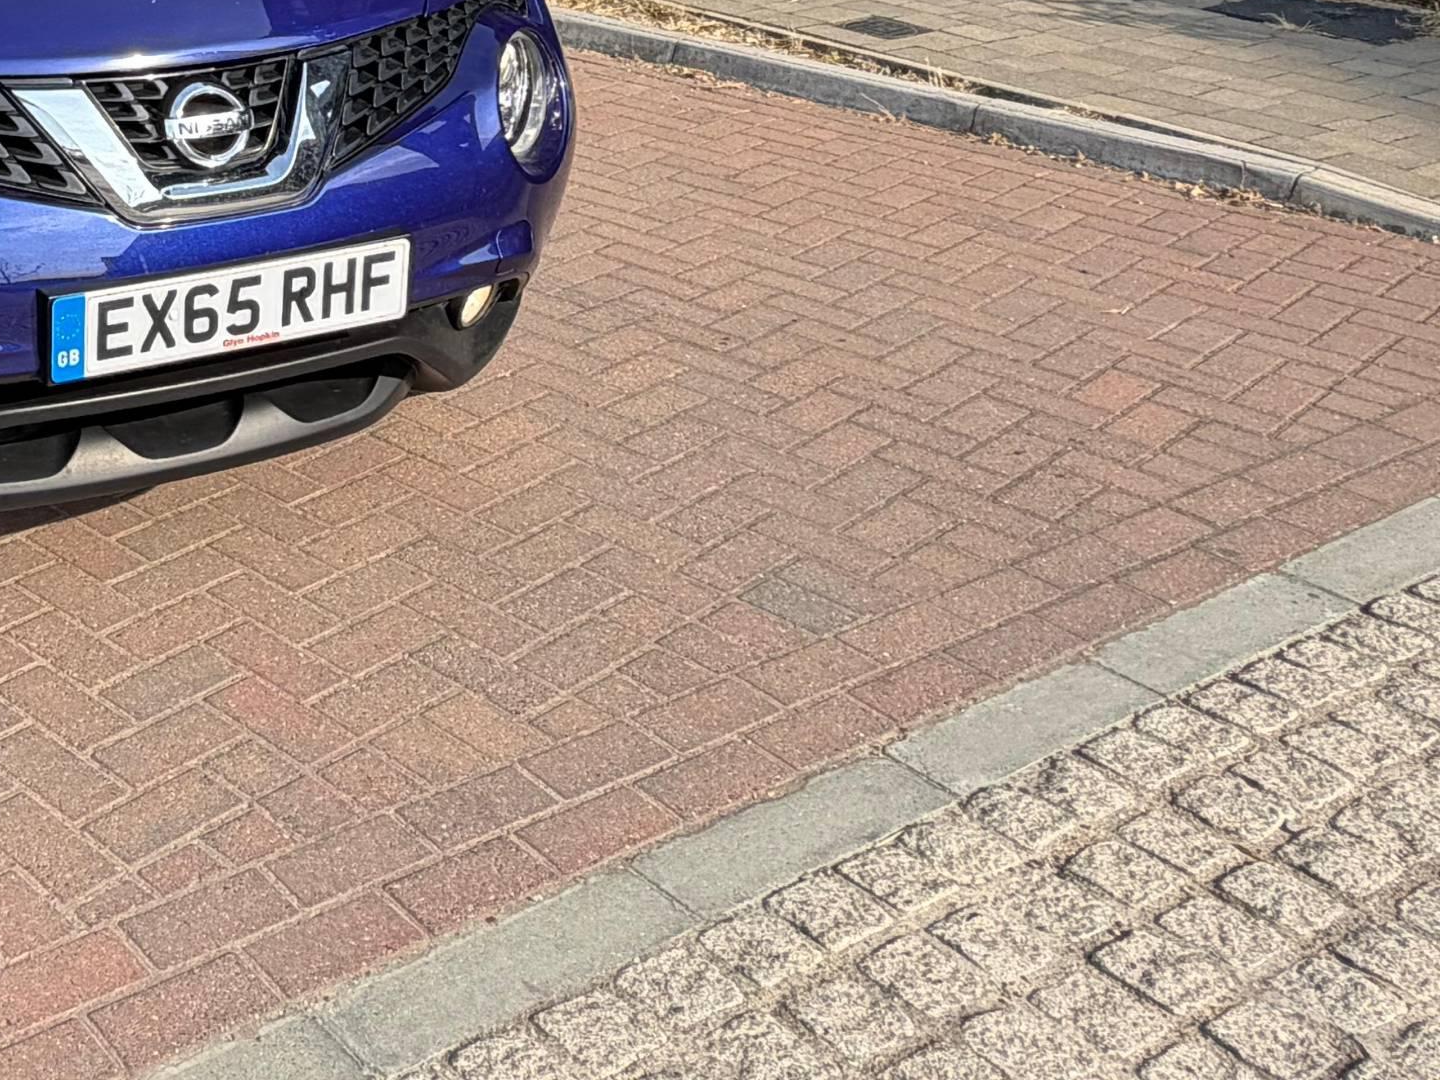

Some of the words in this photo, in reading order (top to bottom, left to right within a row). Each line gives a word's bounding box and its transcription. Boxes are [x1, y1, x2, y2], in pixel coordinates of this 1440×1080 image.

[95, 274, 263, 361] EX65
[281, 250, 396, 328] RHF
[57, 348, 80, 368] GB
